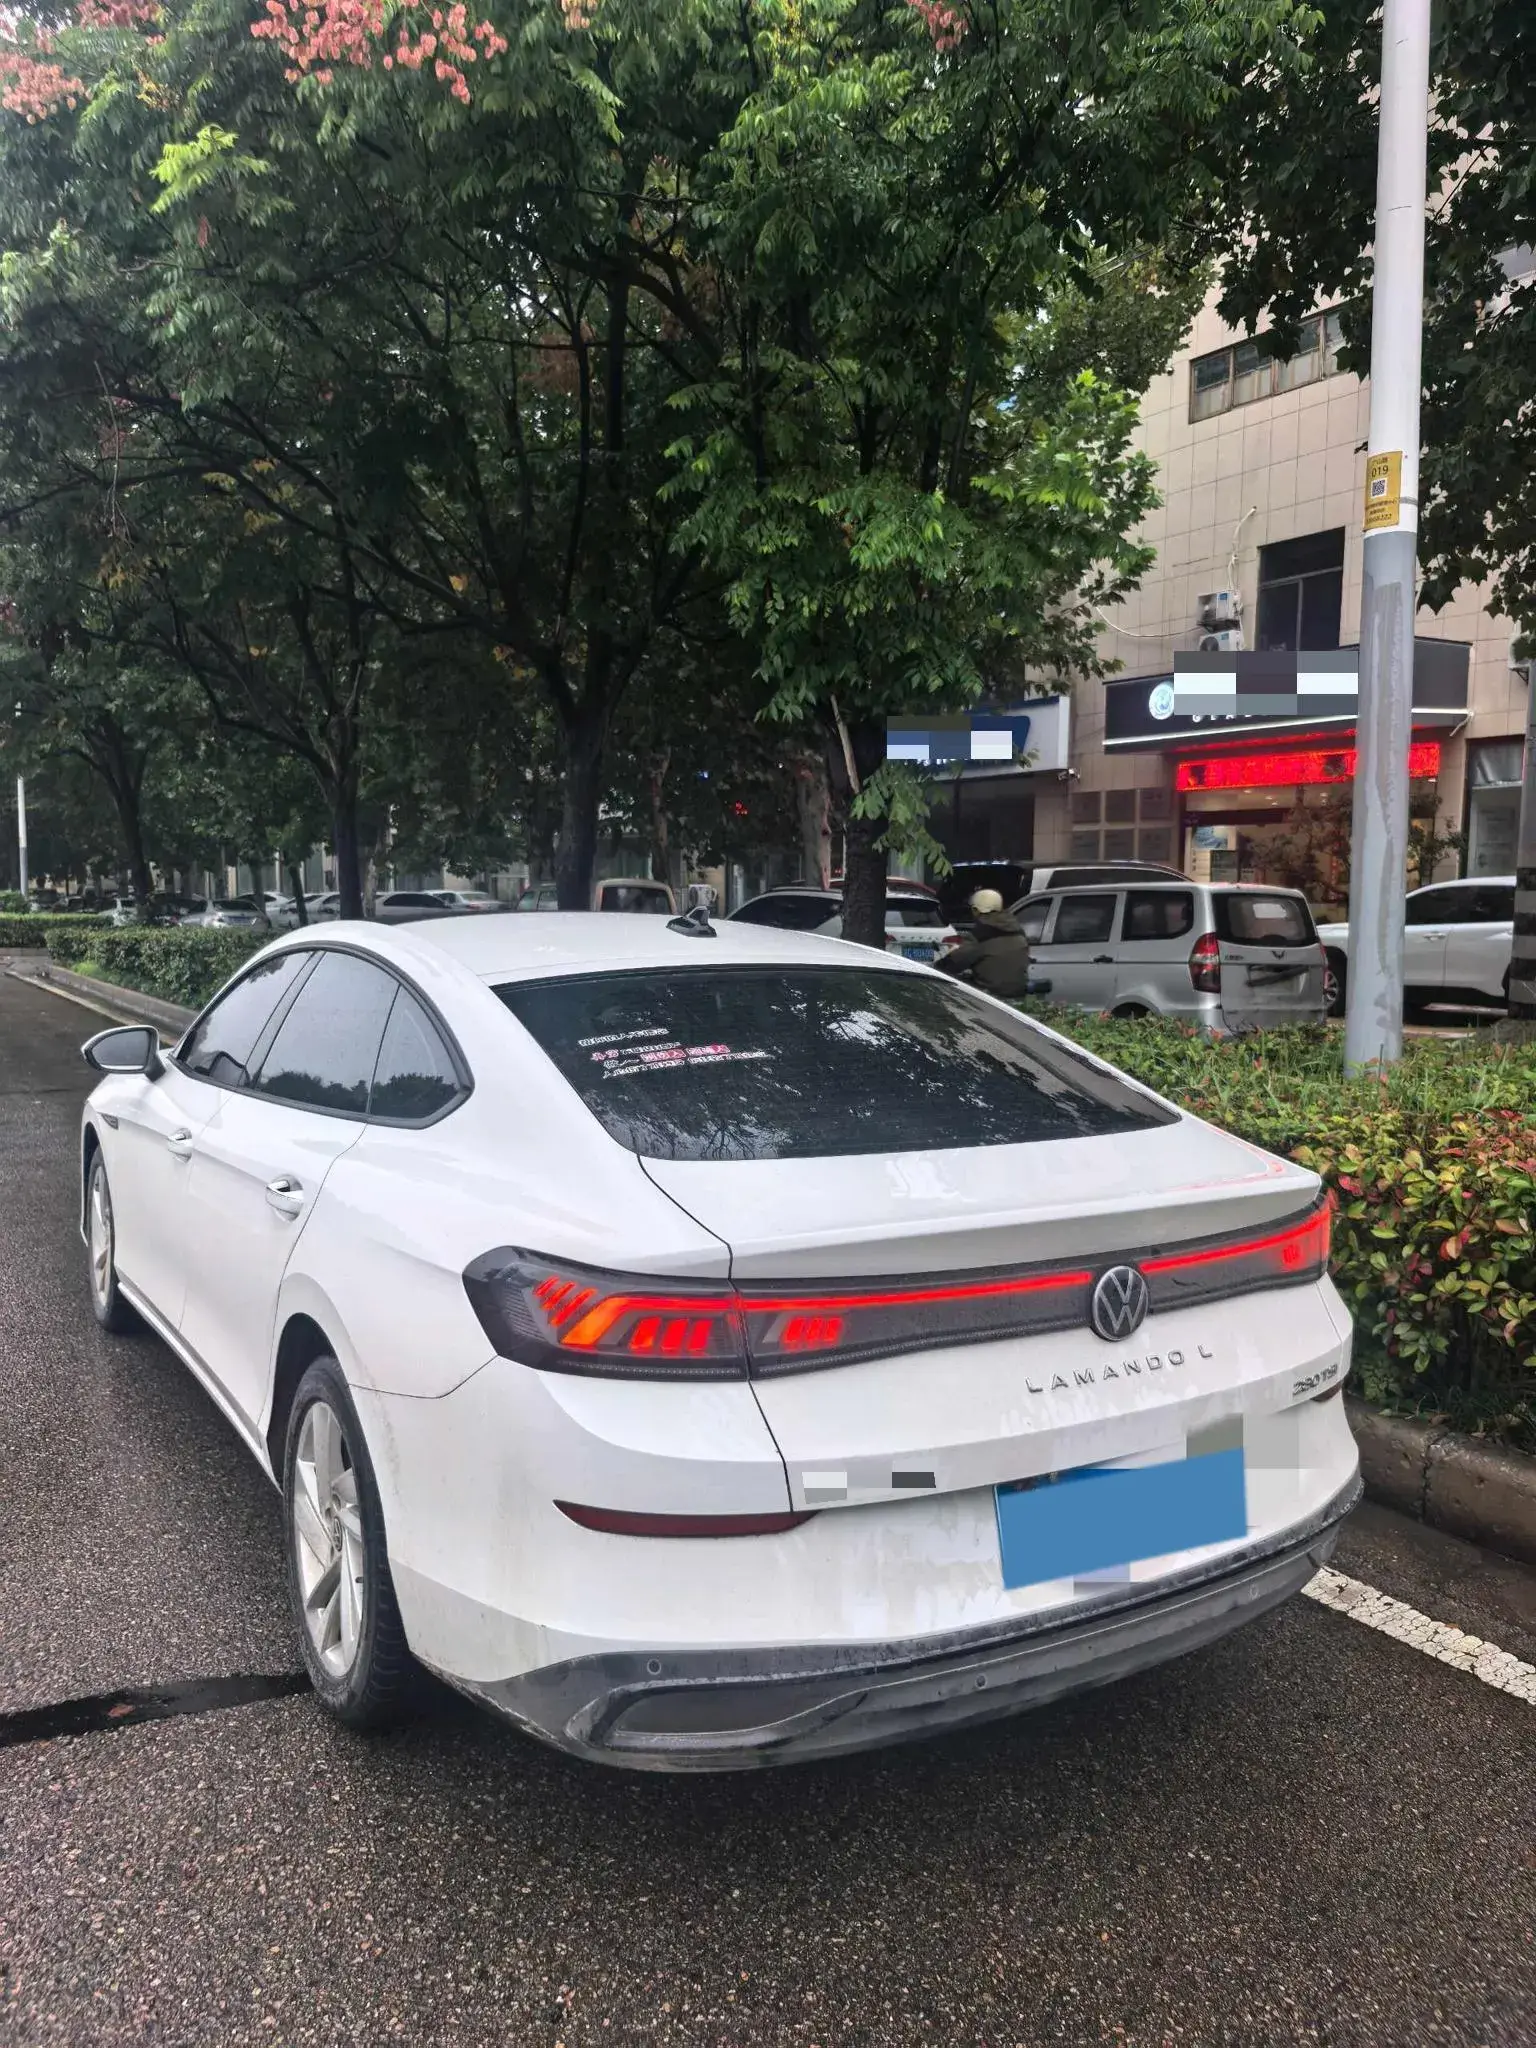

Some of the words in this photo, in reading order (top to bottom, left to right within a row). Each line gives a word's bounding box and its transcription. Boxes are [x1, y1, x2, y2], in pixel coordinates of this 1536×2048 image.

[1371, 464, 1388, 478] 019
[1025, 1348, 1185, 1394] LAMANDO
[1197, 1343, 1214, 1359] L
